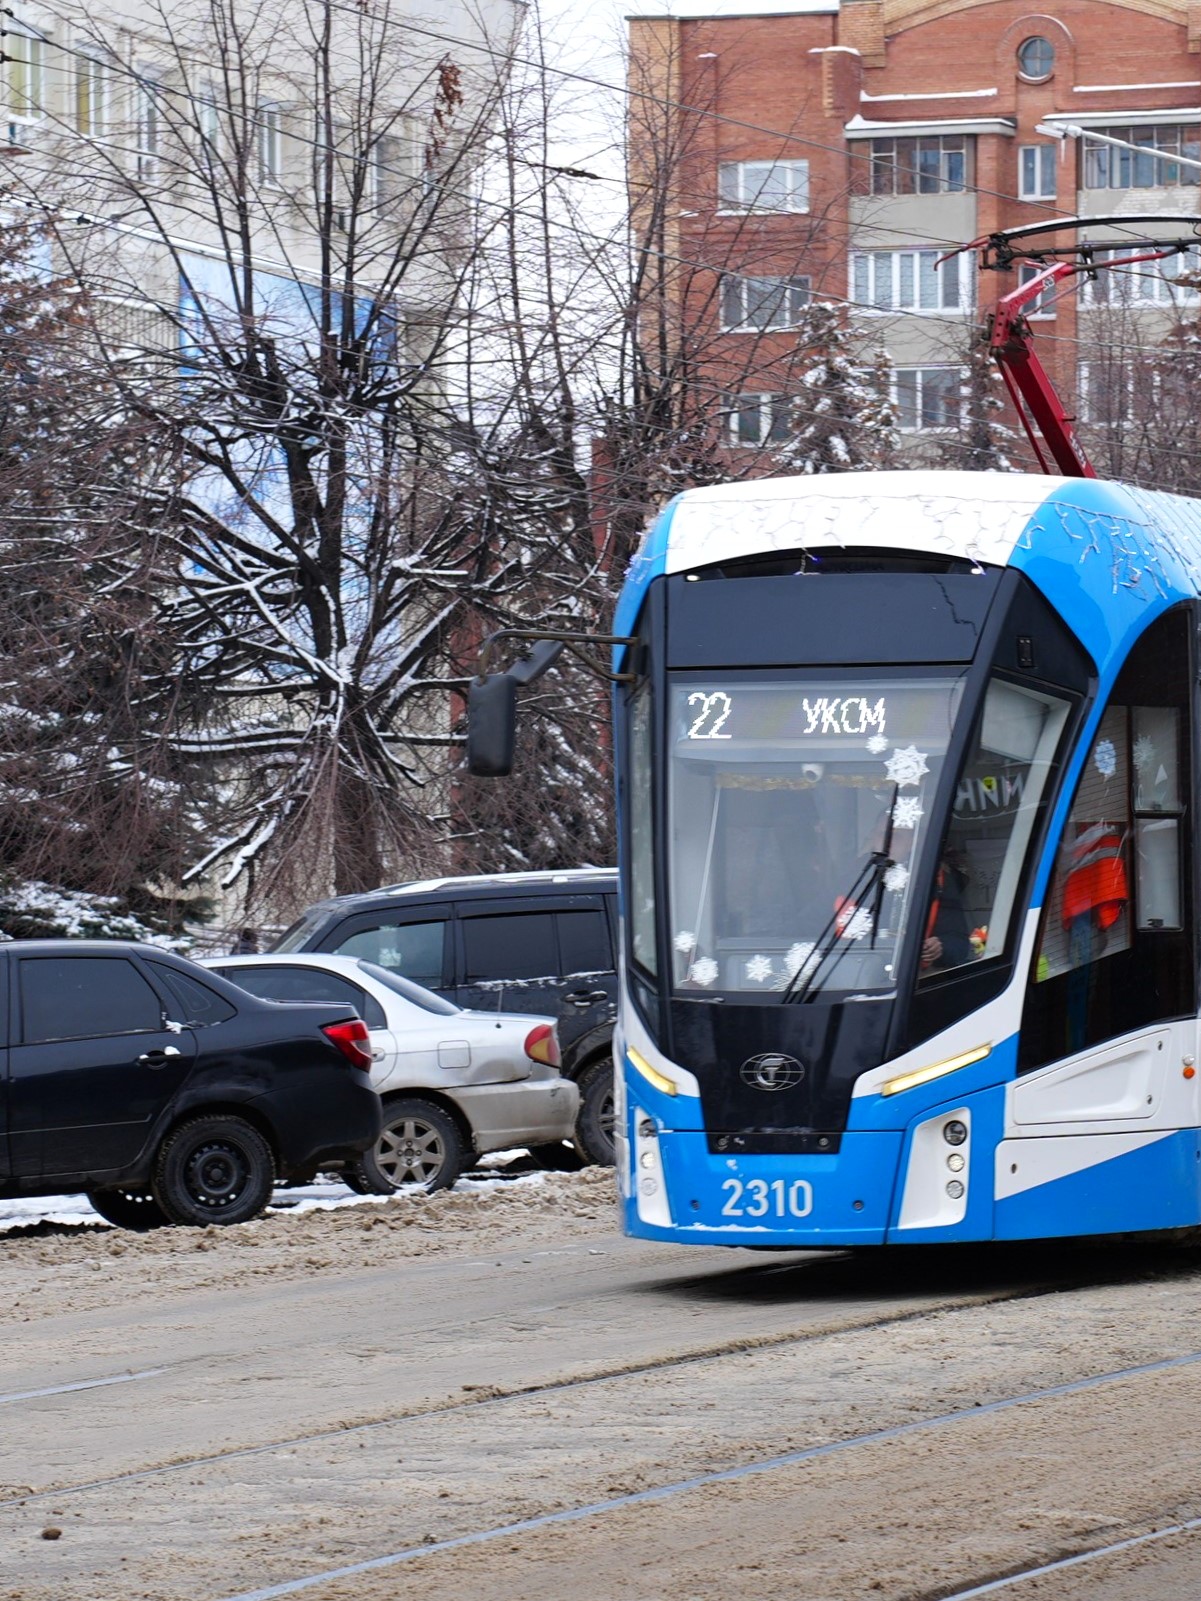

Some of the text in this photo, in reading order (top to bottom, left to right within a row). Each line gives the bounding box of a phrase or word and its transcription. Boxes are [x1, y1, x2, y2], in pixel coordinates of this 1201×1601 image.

[688, 692, 885, 739] 22 УКСМ
[721, 1179, 813, 1217] 2310
